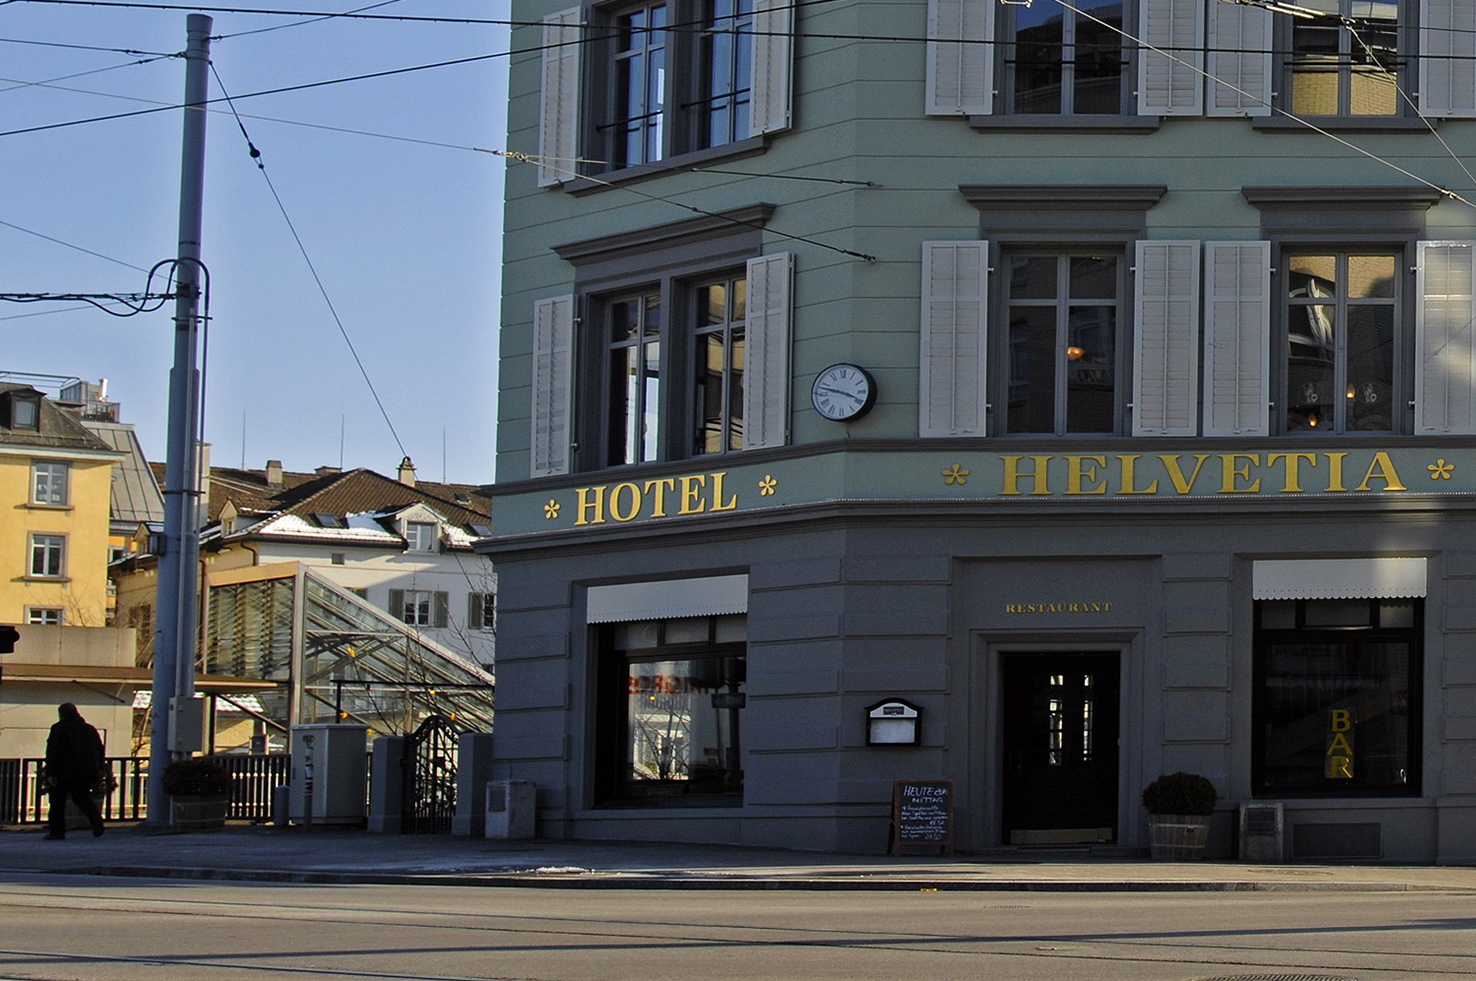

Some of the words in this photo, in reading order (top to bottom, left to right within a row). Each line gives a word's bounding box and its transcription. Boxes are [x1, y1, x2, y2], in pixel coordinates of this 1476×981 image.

[997, 451, 1407, 495] HELVETIA
[574, 471, 738, 525] HOTEL
[1005, 602, 1112, 613] RESTAURANT
[1326, 708, 1353, 778] BAR
[903, 785, 933, 797] HEUTE
